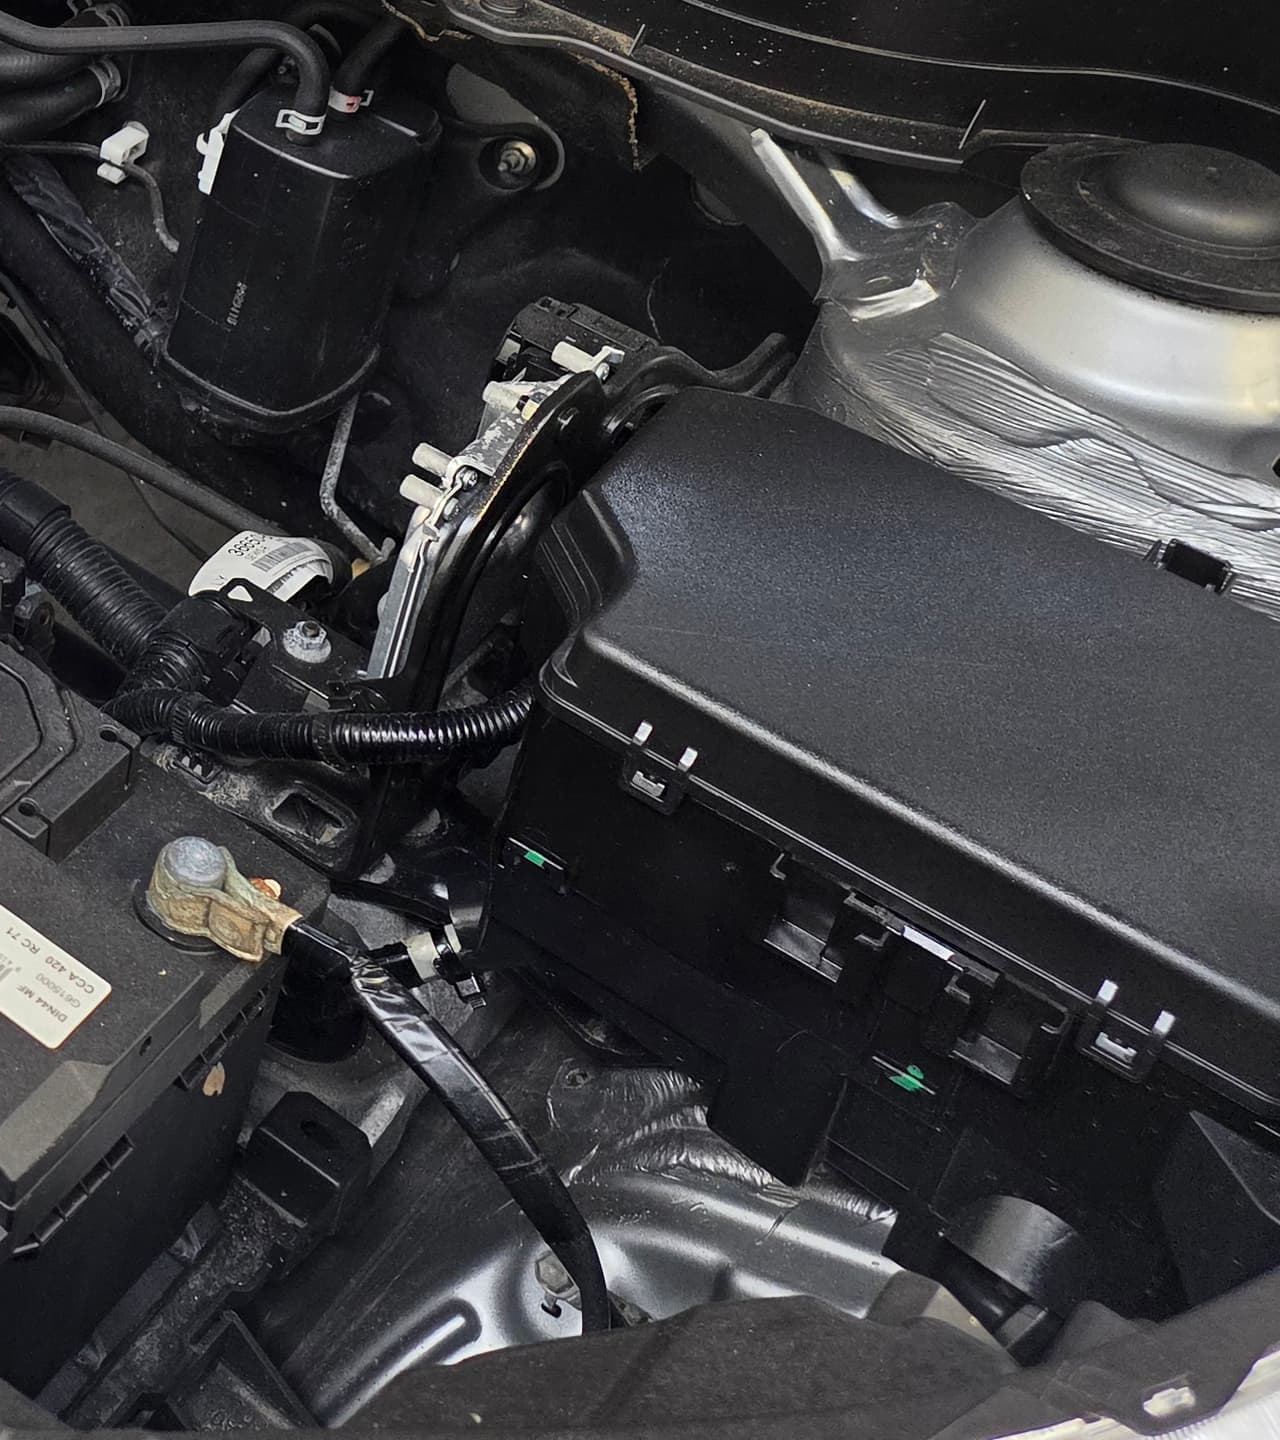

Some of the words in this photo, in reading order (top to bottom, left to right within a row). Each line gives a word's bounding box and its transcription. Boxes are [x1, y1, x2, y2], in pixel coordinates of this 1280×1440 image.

[4, 925, 21, 940] 71
[19, 936, 41, 955] RC
[43, 954, 68, 974] 420
[15, 982, 36, 999] MF
[65, 970, 96, 995] CCA
[33, 994, 69, 1023] DIN44
